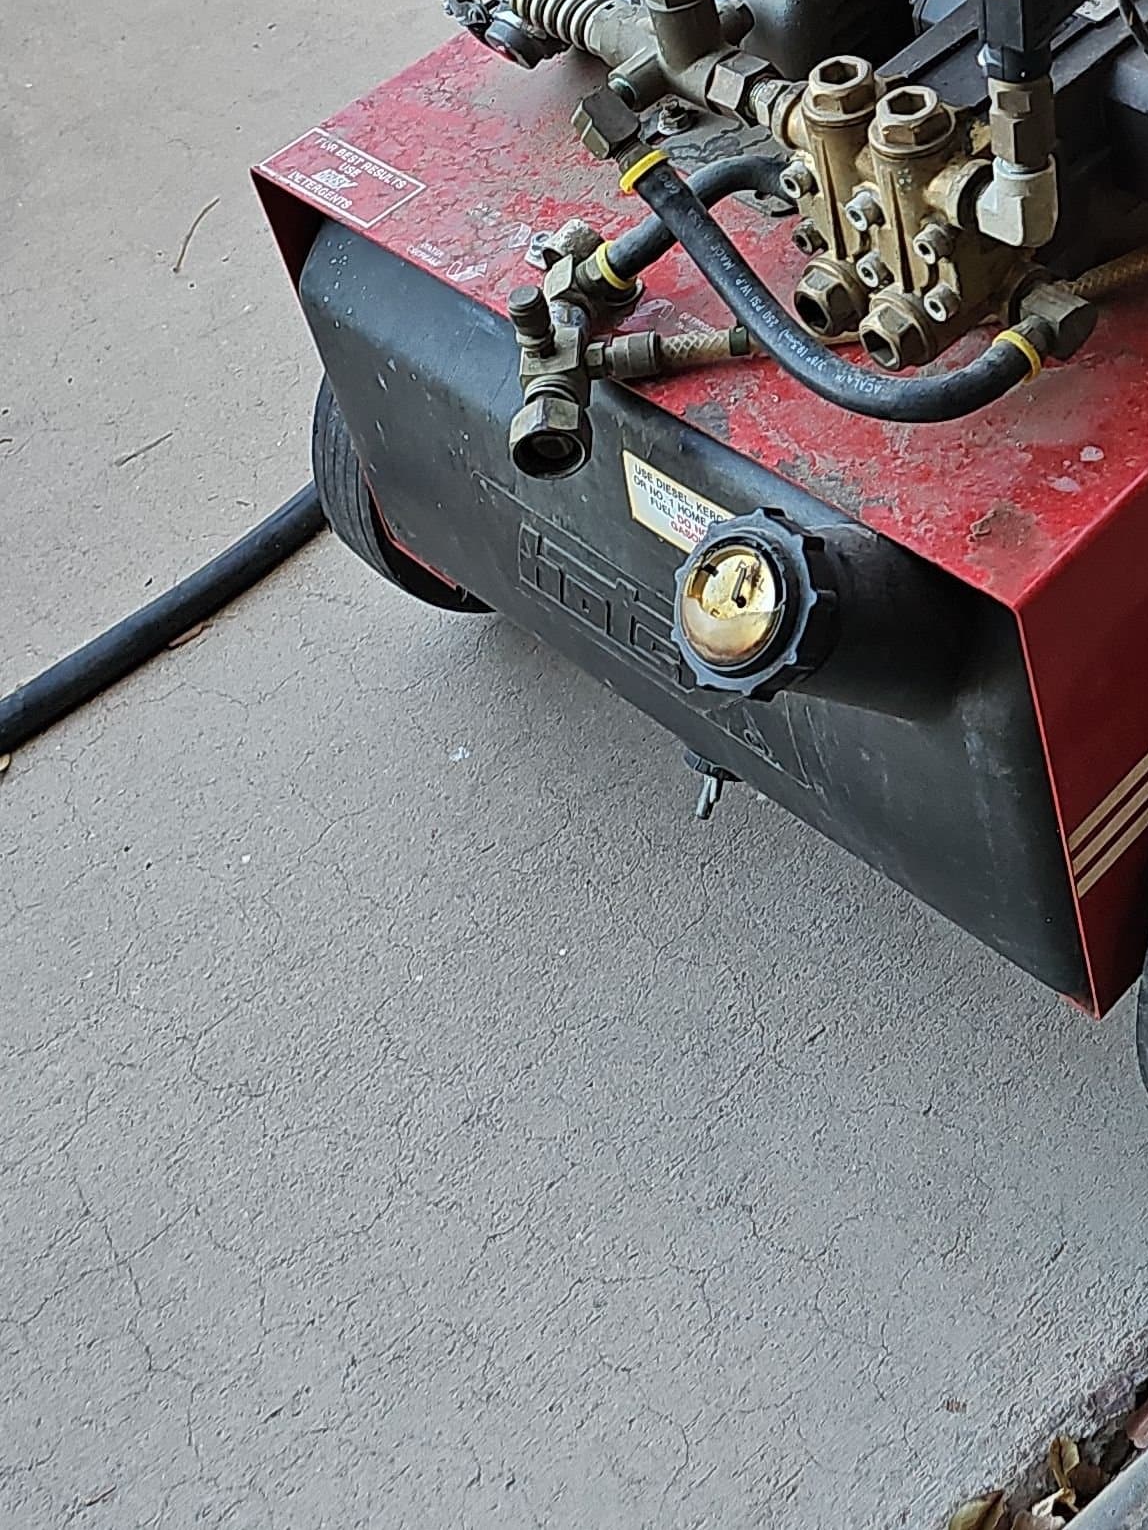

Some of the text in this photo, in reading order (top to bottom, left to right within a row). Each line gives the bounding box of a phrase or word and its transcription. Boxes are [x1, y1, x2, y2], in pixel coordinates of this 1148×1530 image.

[315, 137, 407, 190] FOR BEST RESULTS
[339, 163, 362, 178] USE
[288, 170, 352, 209] DETERGENTS
[749, 296, 767, 313] PSI
[762, 310, 780, 329] 250
[634, 475, 647, 490] OR
[669, 499, 674, 508] 1
[678, 504, 706, 527] HOME
[635, 464, 729, 521] USE DIESEL, KERO
[650, 497, 674, 519] FUEL
[677, 514, 691, 529] DO
[671, 521, 702, 543] GASO
[518, 522, 695, 694] hots
